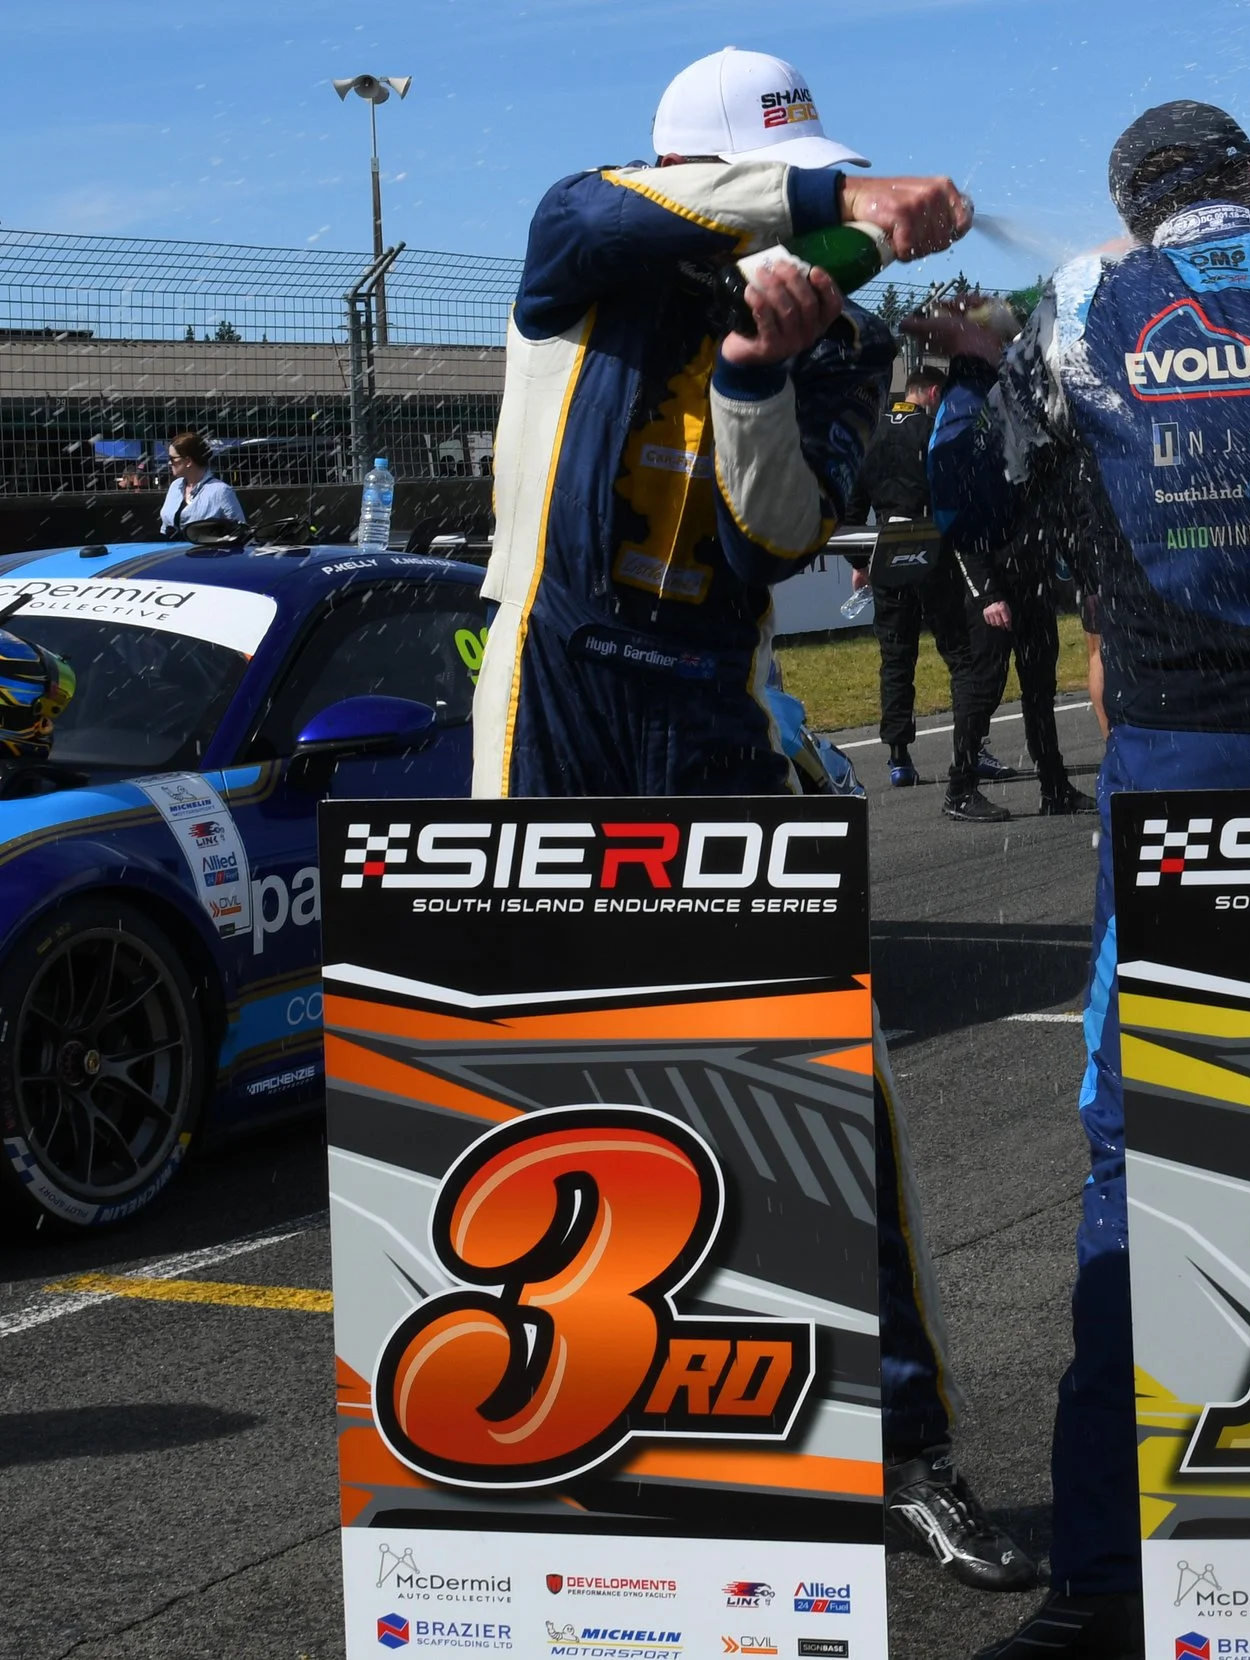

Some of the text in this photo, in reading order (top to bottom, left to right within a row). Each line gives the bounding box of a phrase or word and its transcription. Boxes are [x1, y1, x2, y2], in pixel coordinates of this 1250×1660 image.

[1155, 484, 1244, 504] Southland
[891, 550, 928, 565] PK
[322, 558, 379, 575] P.KELLY
[29, 600, 170, 622] OLLECTIVE
[585, 635, 678, 668] Hugh Gardiner
[170, 799, 212, 813] MICHELIN
[202, 851, 238, 873] Allied
[381, 822, 849, 888] SIERDC
[412, 897, 838, 912] SOUTH ISLAND ENDURANCE SERIES
[396, 1572, 511, 1593] McDermid
[566, 1576, 677, 1592] DEVELOPMENTS
[794, 1581, 851, 1599] Allied
[397, 1593, 512, 1604] AUTO COLLECTIVE
[567, 1588, 677, 1600] PERFORMANCE DYNO FACILITY
[830, 1603, 849, 1611] Fuel
[416, 1620, 512, 1640] BRAZIER
[581, 1627, 682, 1643] MICHELIN
[416, 1637, 513, 1650] SCAFFOLDING LTD
[740, 1635, 778, 1648] CIVIL
[803, 1643, 844, 1653] SIGNBASE
[551, 1645, 682, 1660] MOTORSPORT
